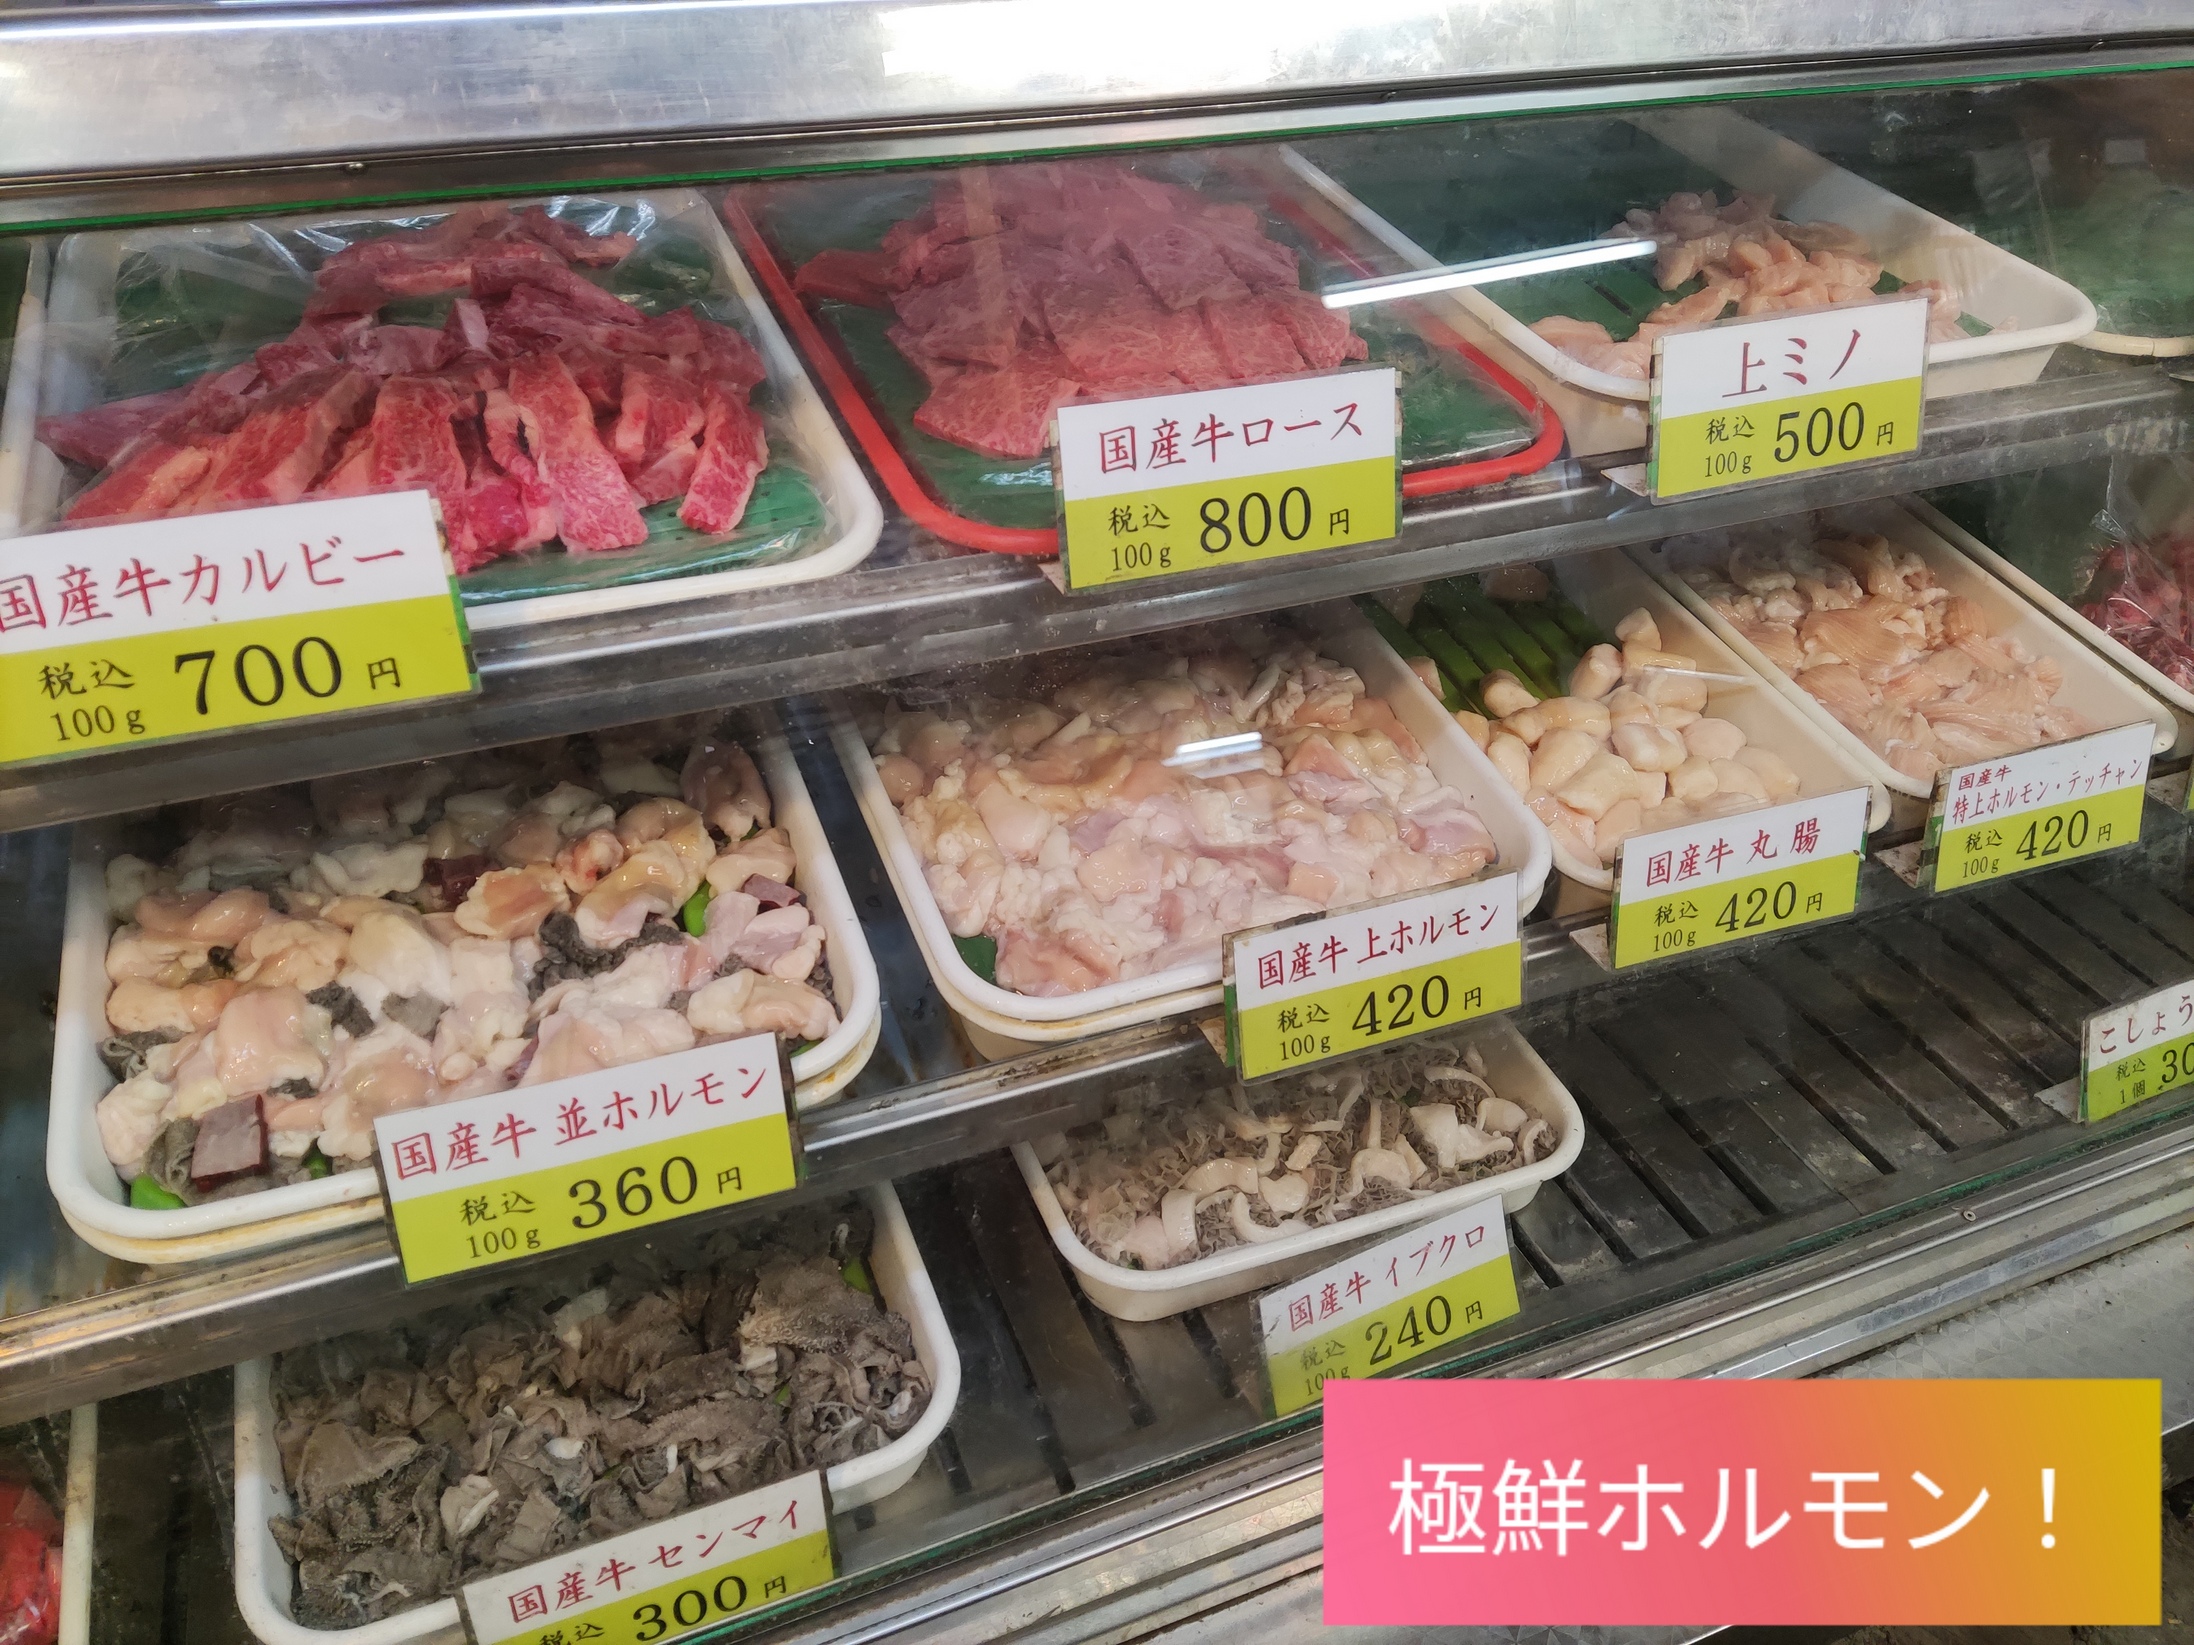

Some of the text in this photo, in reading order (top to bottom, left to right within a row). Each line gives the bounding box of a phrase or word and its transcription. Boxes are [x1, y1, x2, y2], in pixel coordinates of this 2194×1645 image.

[1722, 329, 1861, 398] 上ミノ
[1099, 403, 1362, 474] 国産牛ロース
[1705, 415, 1754, 444] 税込
[1108, 504, 1170, 536] 税込
[0, 537, 404, 631] 国産牛カルビー
[39, 659, 135, 699] 税込
[1958, 765, 2012, 791] 国産牛
[1964, 829, 2003, 854] 税込
[1654, 900, 1698, 927] 税込
[1277, 1003, 1330, 1033] 税込
[2116, 1058, 2146, 1081] 税込
[460, 1191, 536, 1226] 税込
[1301, 1340, 1347, 1371] 税込
